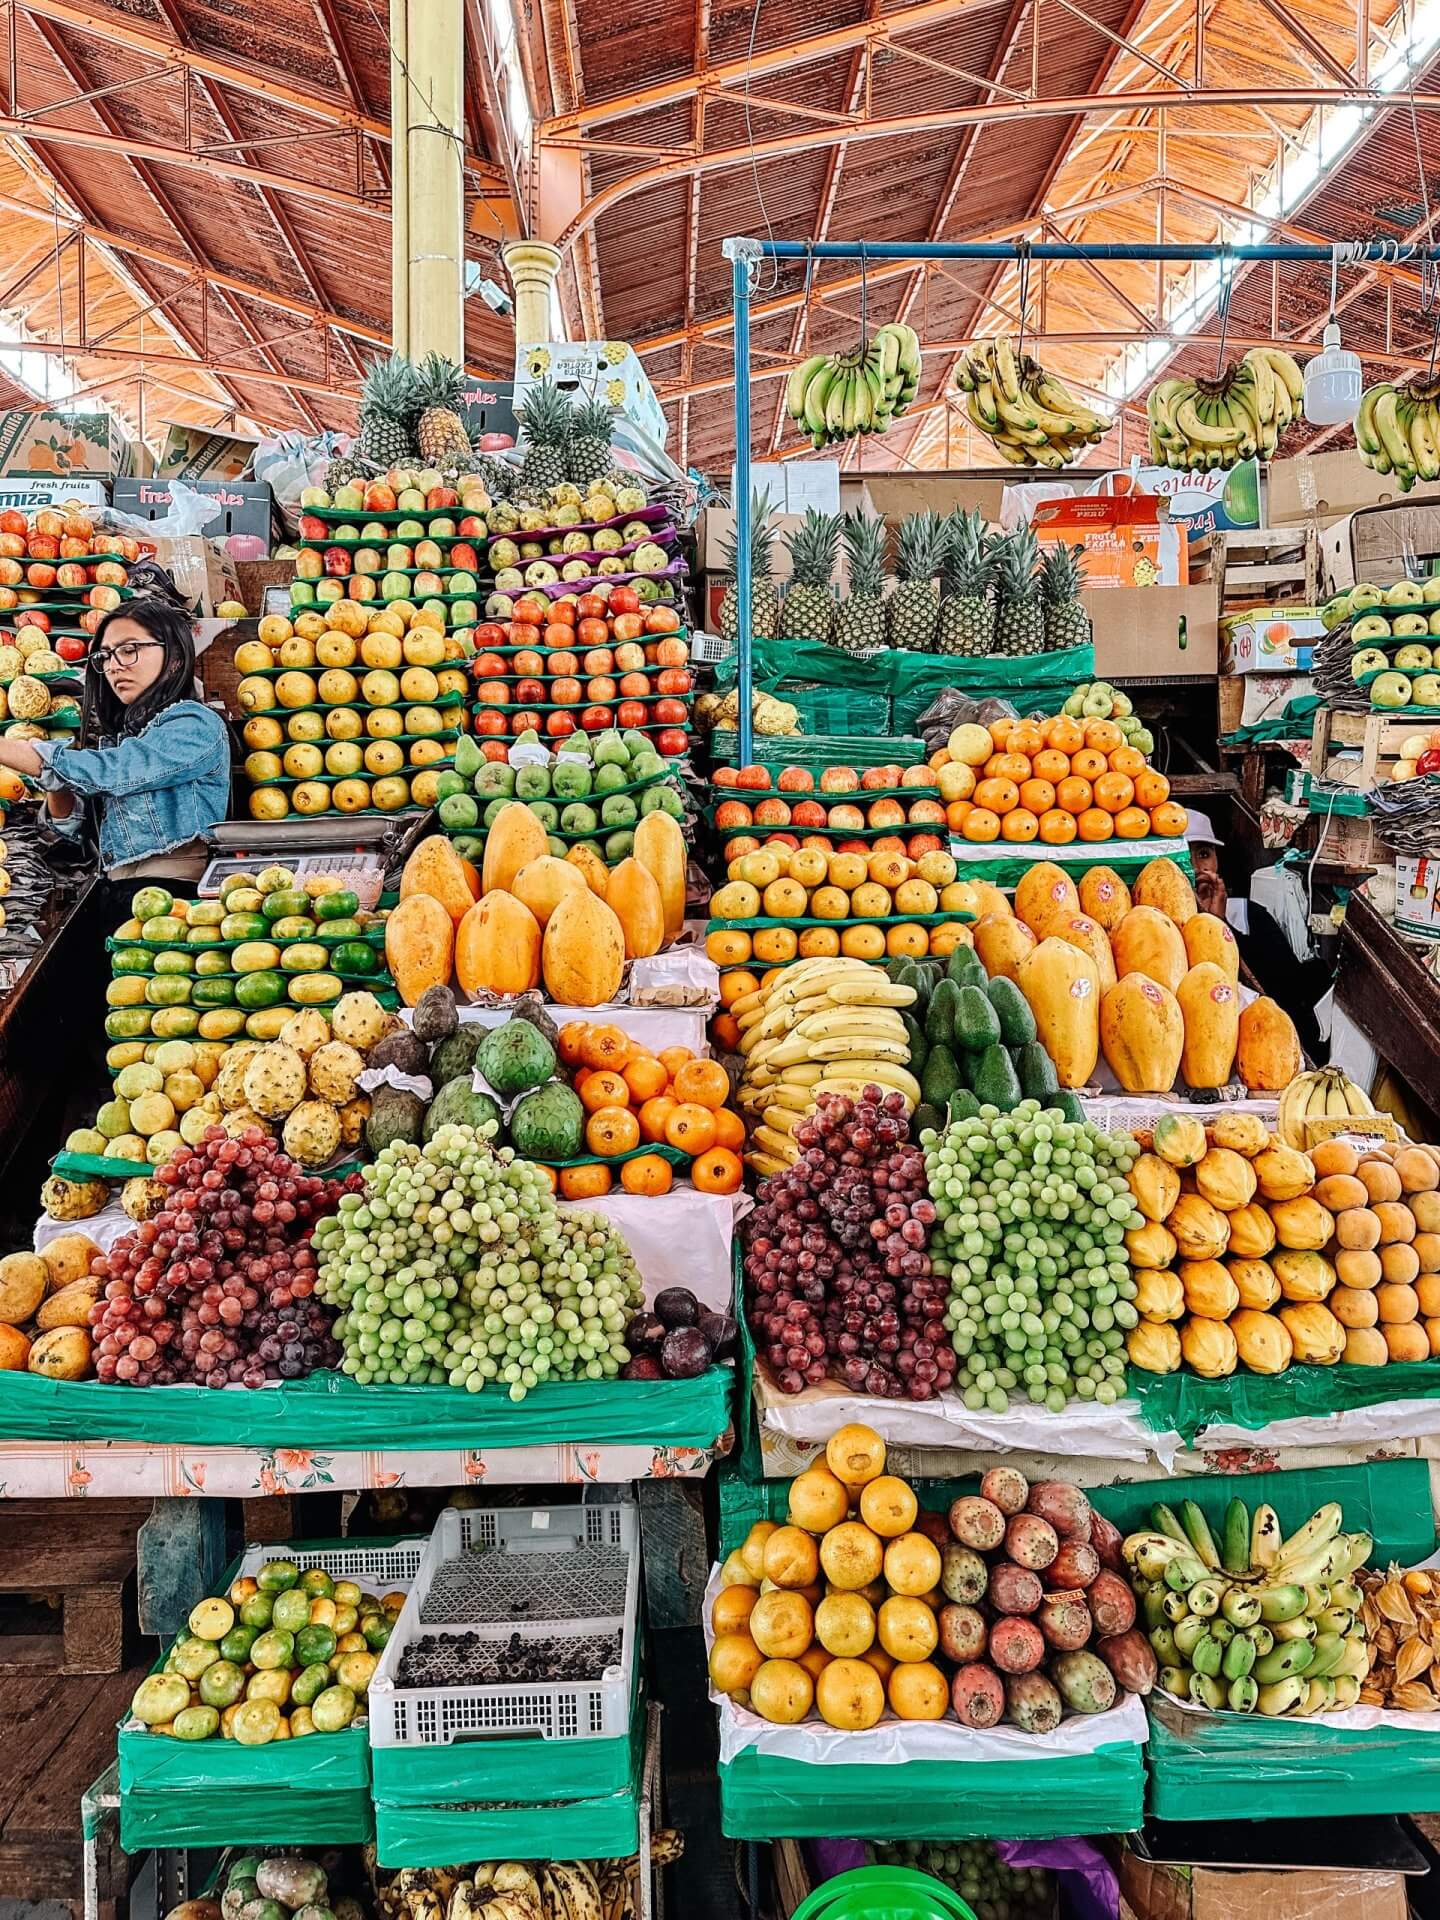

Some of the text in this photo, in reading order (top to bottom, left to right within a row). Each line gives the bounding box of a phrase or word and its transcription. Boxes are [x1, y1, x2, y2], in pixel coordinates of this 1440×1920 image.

[460, 387, 497, 412] ples
[185, 435, 228, 480] Granadill
[30, 480, 91, 490] fresh fruits
[139, 485, 172, 504] Fres
[1153, 473, 1222, 494] Apples
[1167, 510, 1217, 533] Fre
